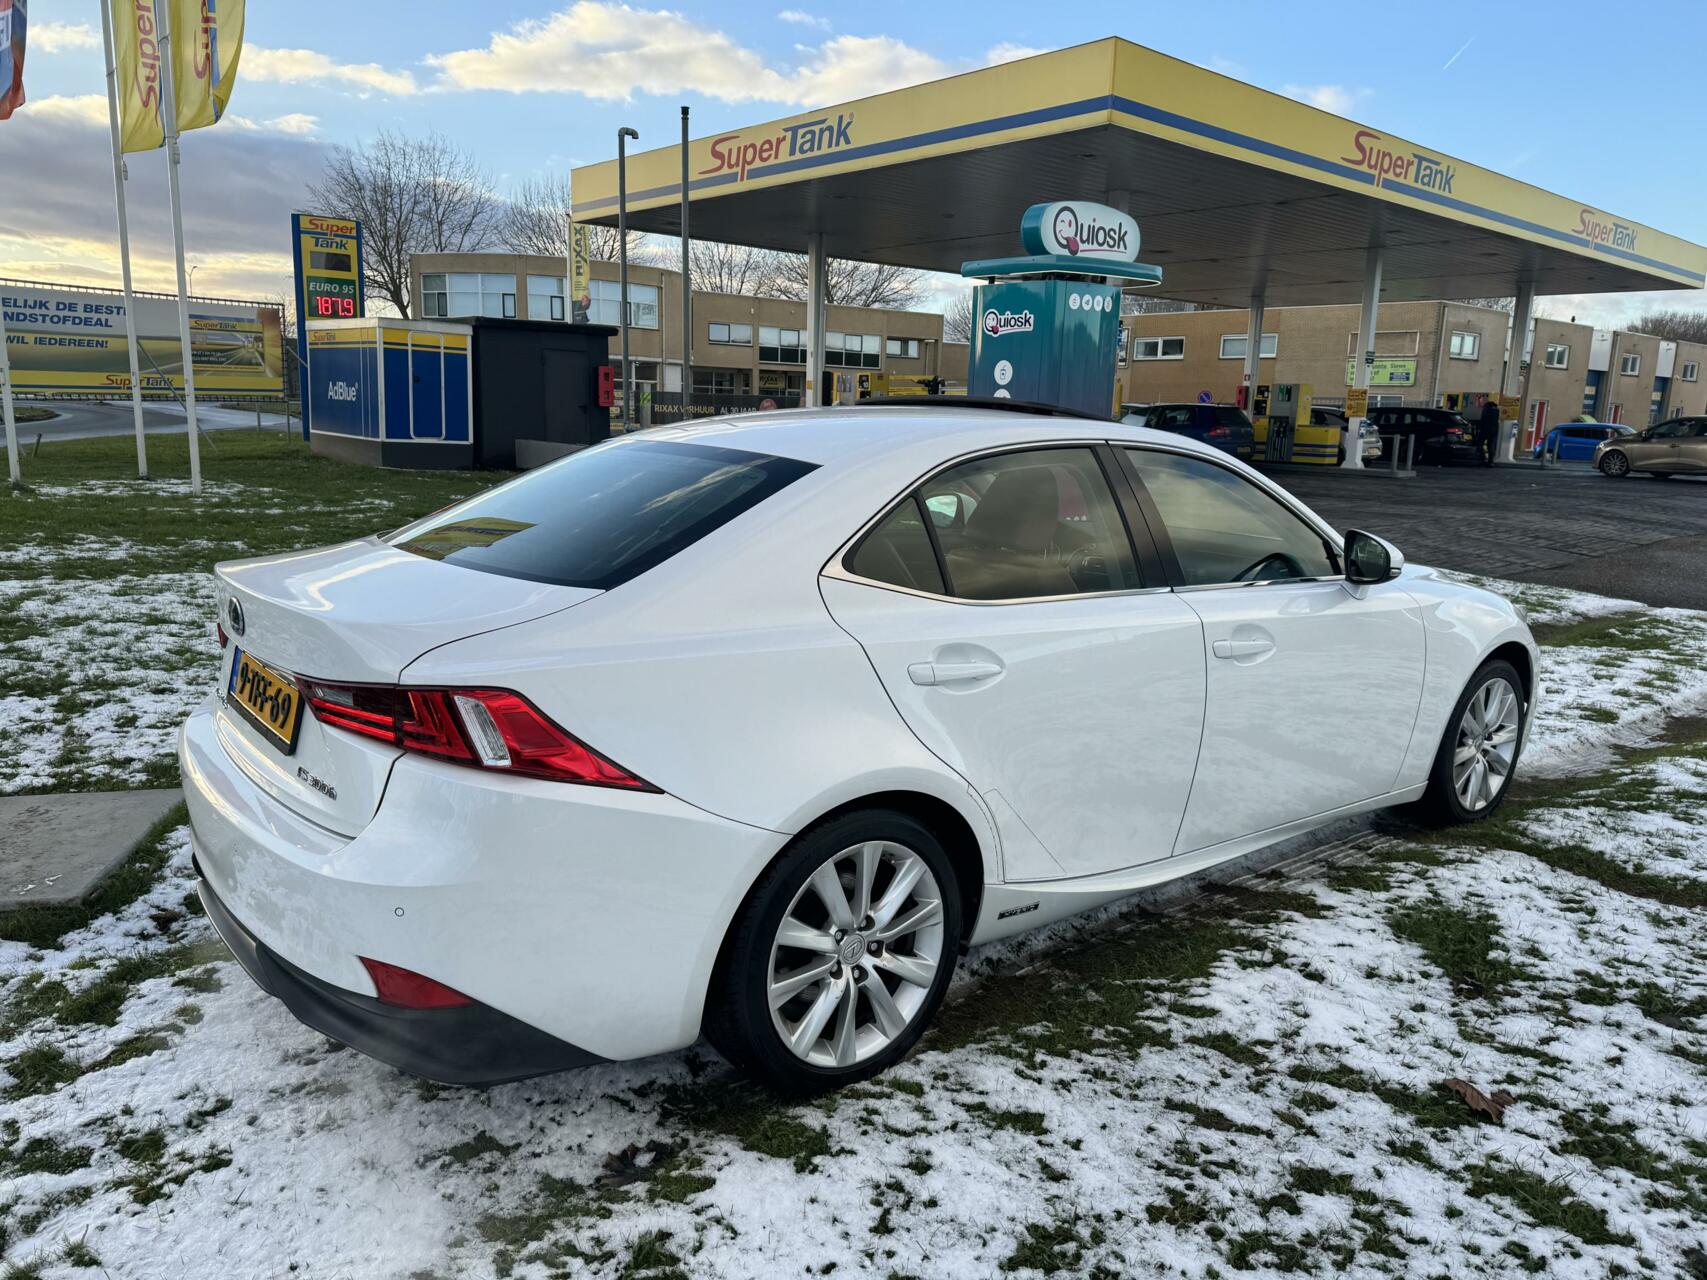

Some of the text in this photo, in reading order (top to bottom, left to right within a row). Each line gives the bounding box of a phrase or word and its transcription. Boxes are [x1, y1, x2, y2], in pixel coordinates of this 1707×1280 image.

[698, 114, 854, 181] SuperTank
[1340, 130, 1455, 194] SuperTank
[302, 218, 355, 237] Super
[1053, 206, 1127, 256] Quiosk
[1571, 208, 1638, 251] SuperTank
[310, 236, 348, 250] Tank
[309, 282, 354, 294] EURO 95
[56, 301, 78, 312] DE
[83, 304, 127, 316] BEST
[985, 311, 1032, 335] Quiosk
[34, 336, 108, 349] IEDEREEN!
[100, 374, 175, 390] SuprTank
[654, 404, 679, 413] RIXAX
